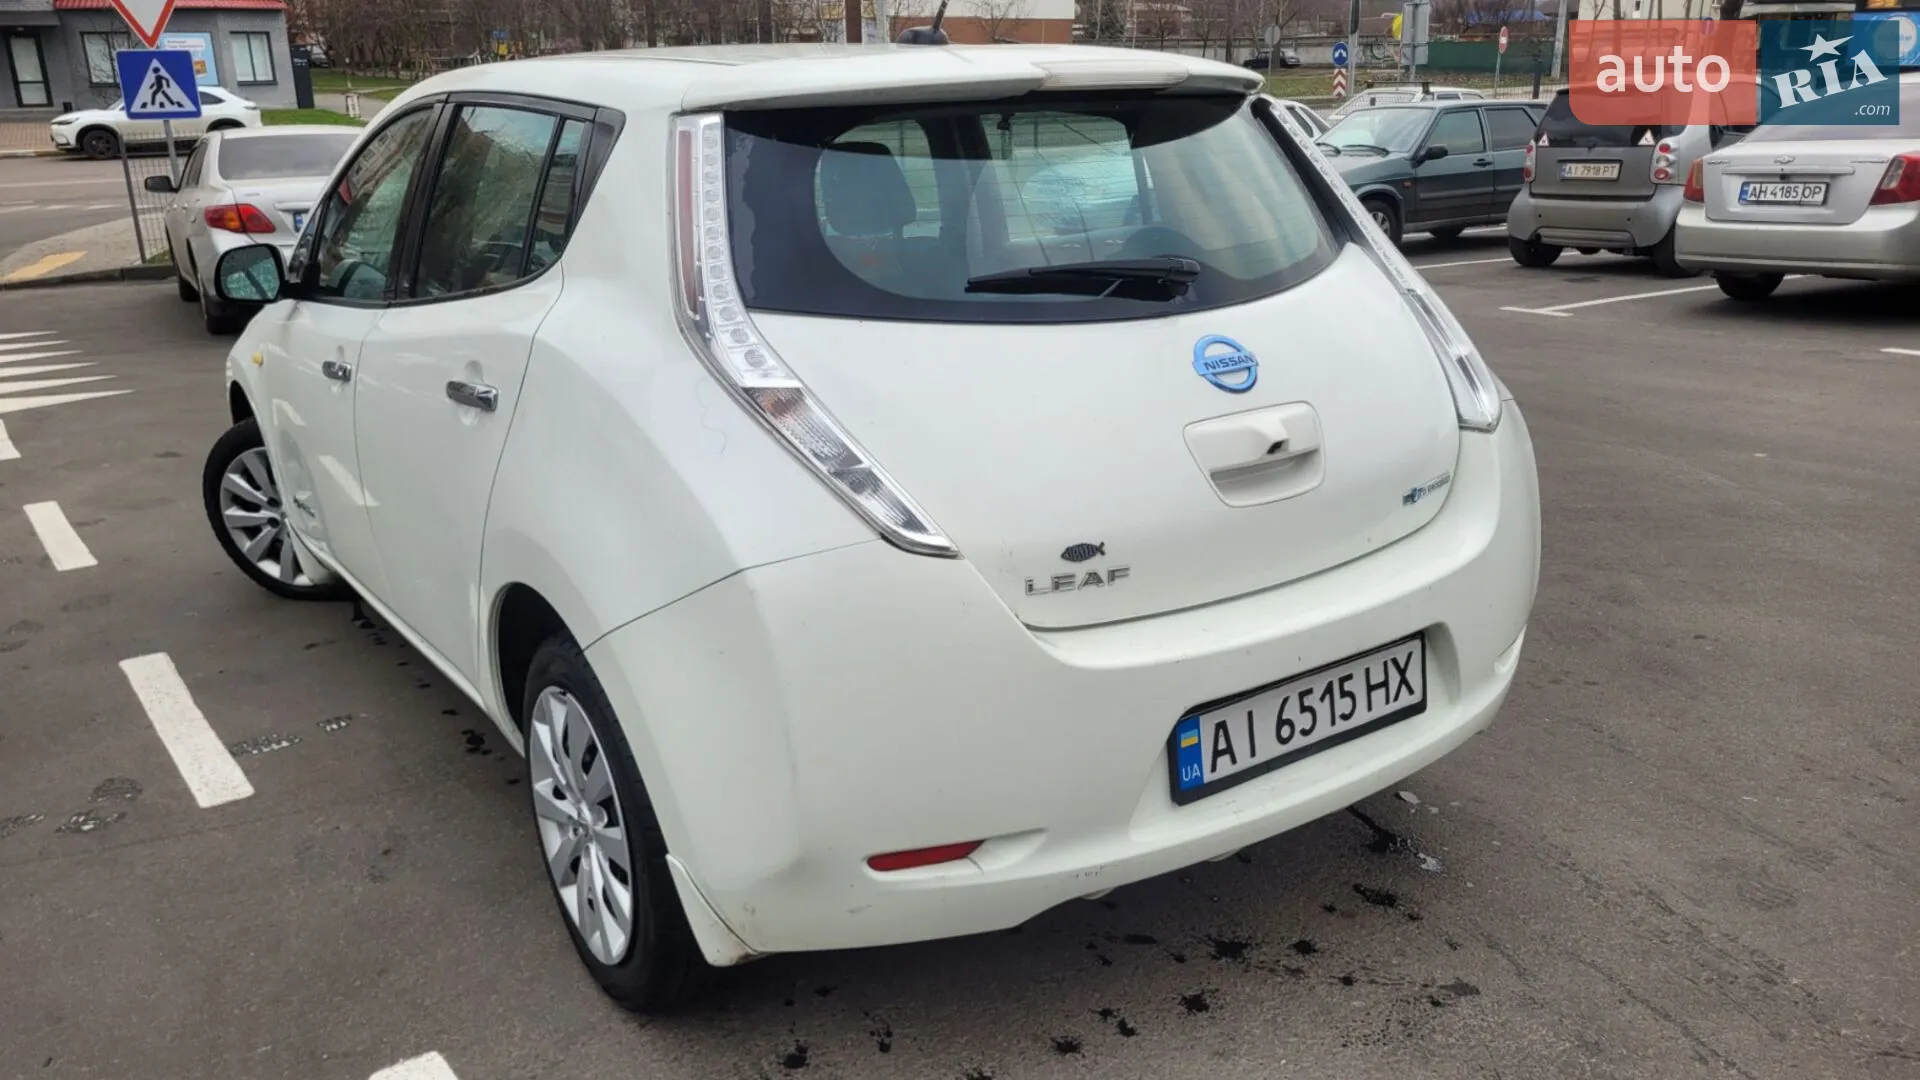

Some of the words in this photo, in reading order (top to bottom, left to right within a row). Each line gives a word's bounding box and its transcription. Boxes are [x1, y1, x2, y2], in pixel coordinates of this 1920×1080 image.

[1749, 185, 1769, 199] AH
[1770, 185, 1799, 199] 4185
[1802, 185, 1822, 199] OP
[1203, 355, 1255, 371] NISSAN
[1025, 566, 1130, 596] LEAF
[1210, 709, 1256, 773] AI
[1275, 672, 1357, 746] 6515
[1364, 651, 1415, 713] HX
[1182, 763, 1201, 782] UA
